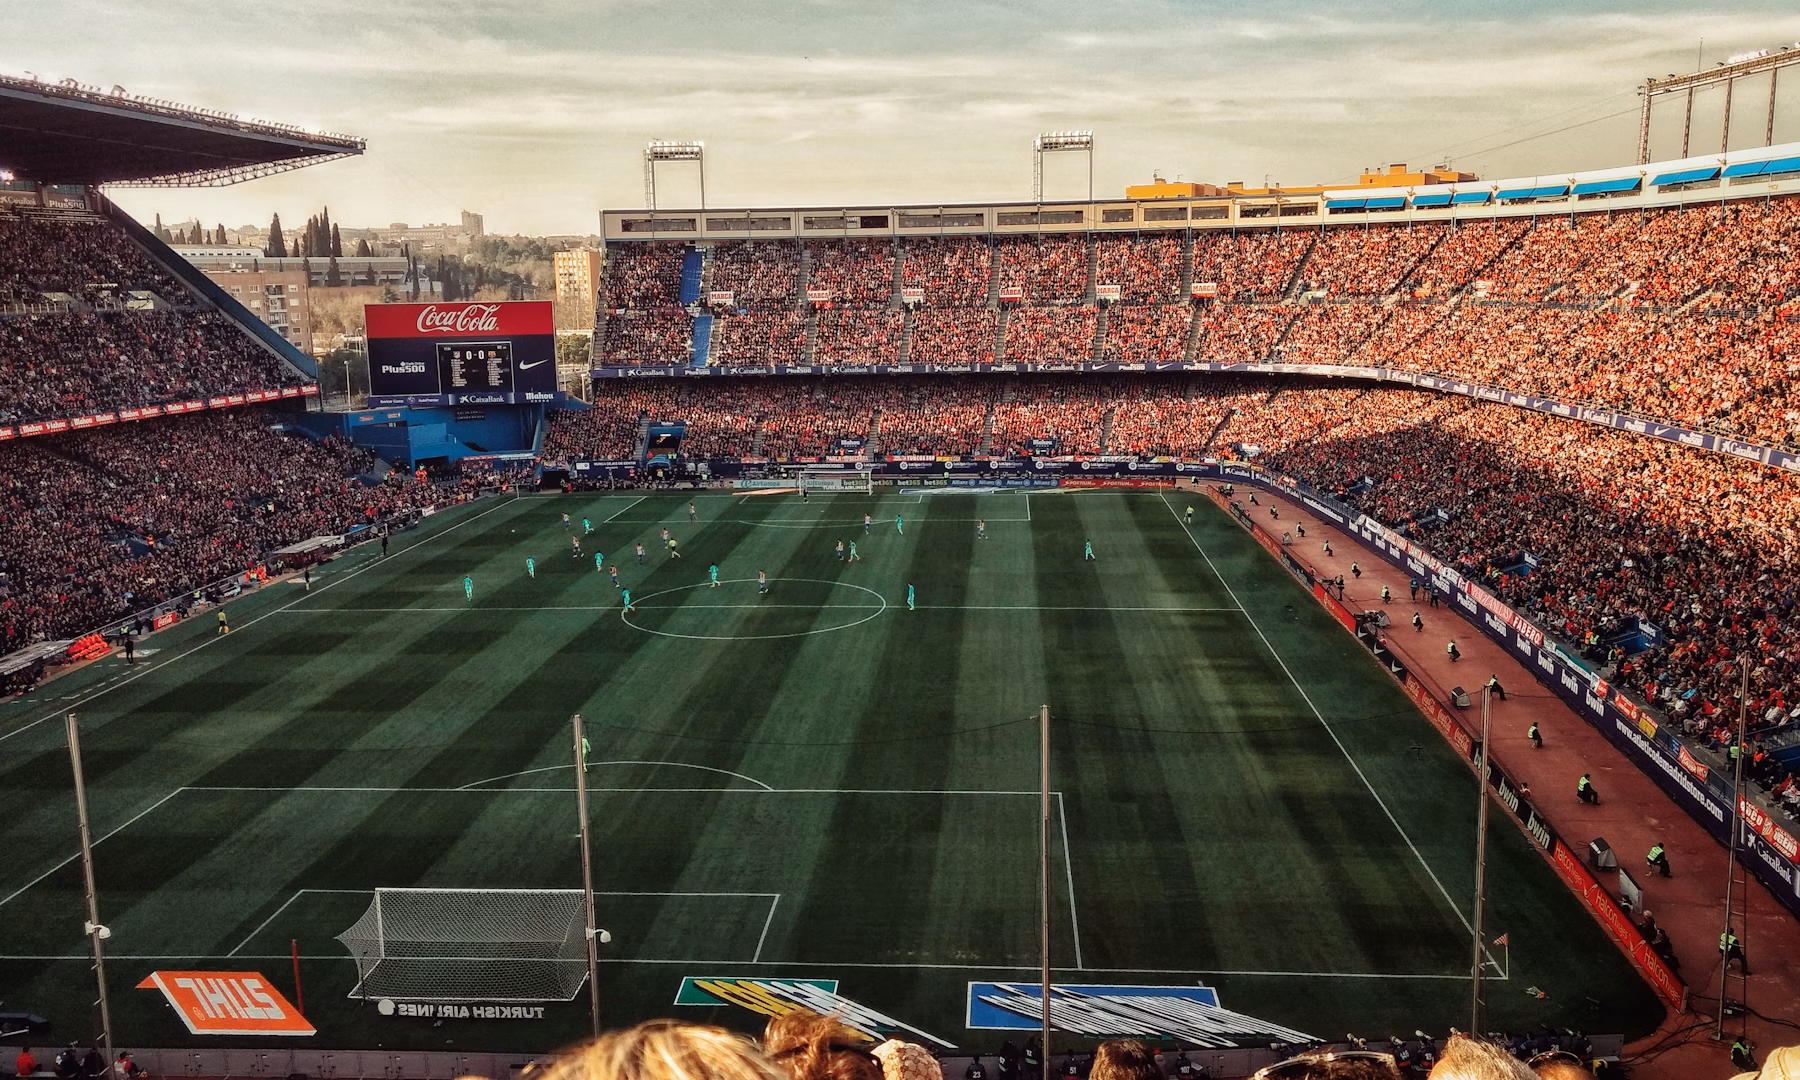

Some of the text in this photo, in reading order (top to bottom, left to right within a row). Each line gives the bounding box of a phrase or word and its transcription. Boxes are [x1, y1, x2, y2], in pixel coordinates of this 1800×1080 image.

[1097, 286, 1120, 294] MARCA
[416, 304, 501, 332] Coca-Cola
[381, 365, 426, 374] Plus500
[469, 395, 504, 403] CaixaBank
[525, 392, 554, 400] Mahou
[22, 423, 43, 433] Mahou
[1512, 615, 1542, 646] FABERO
[1517, 633, 1531, 656] bwin
[1538, 650, 1554, 675] bwin
[1561, 668, 1578, 695] bwin
[1585, 689, 1604, 717] bwin
[1616, 718, 1724, 823] www.atleticodemadridstore.com
[1498, 776, 1519, 813] bwin
[1527, 810, 1551, 850] bwin
[1757, 840, 1792, 885] CaixaBank
[174, 977, 287, 1020] STIHL
[972, 1071, 981, 1079] 23
[1069, 1066, 1077, 1074] 51
[1180, 1065, 1191, 1074] 107
